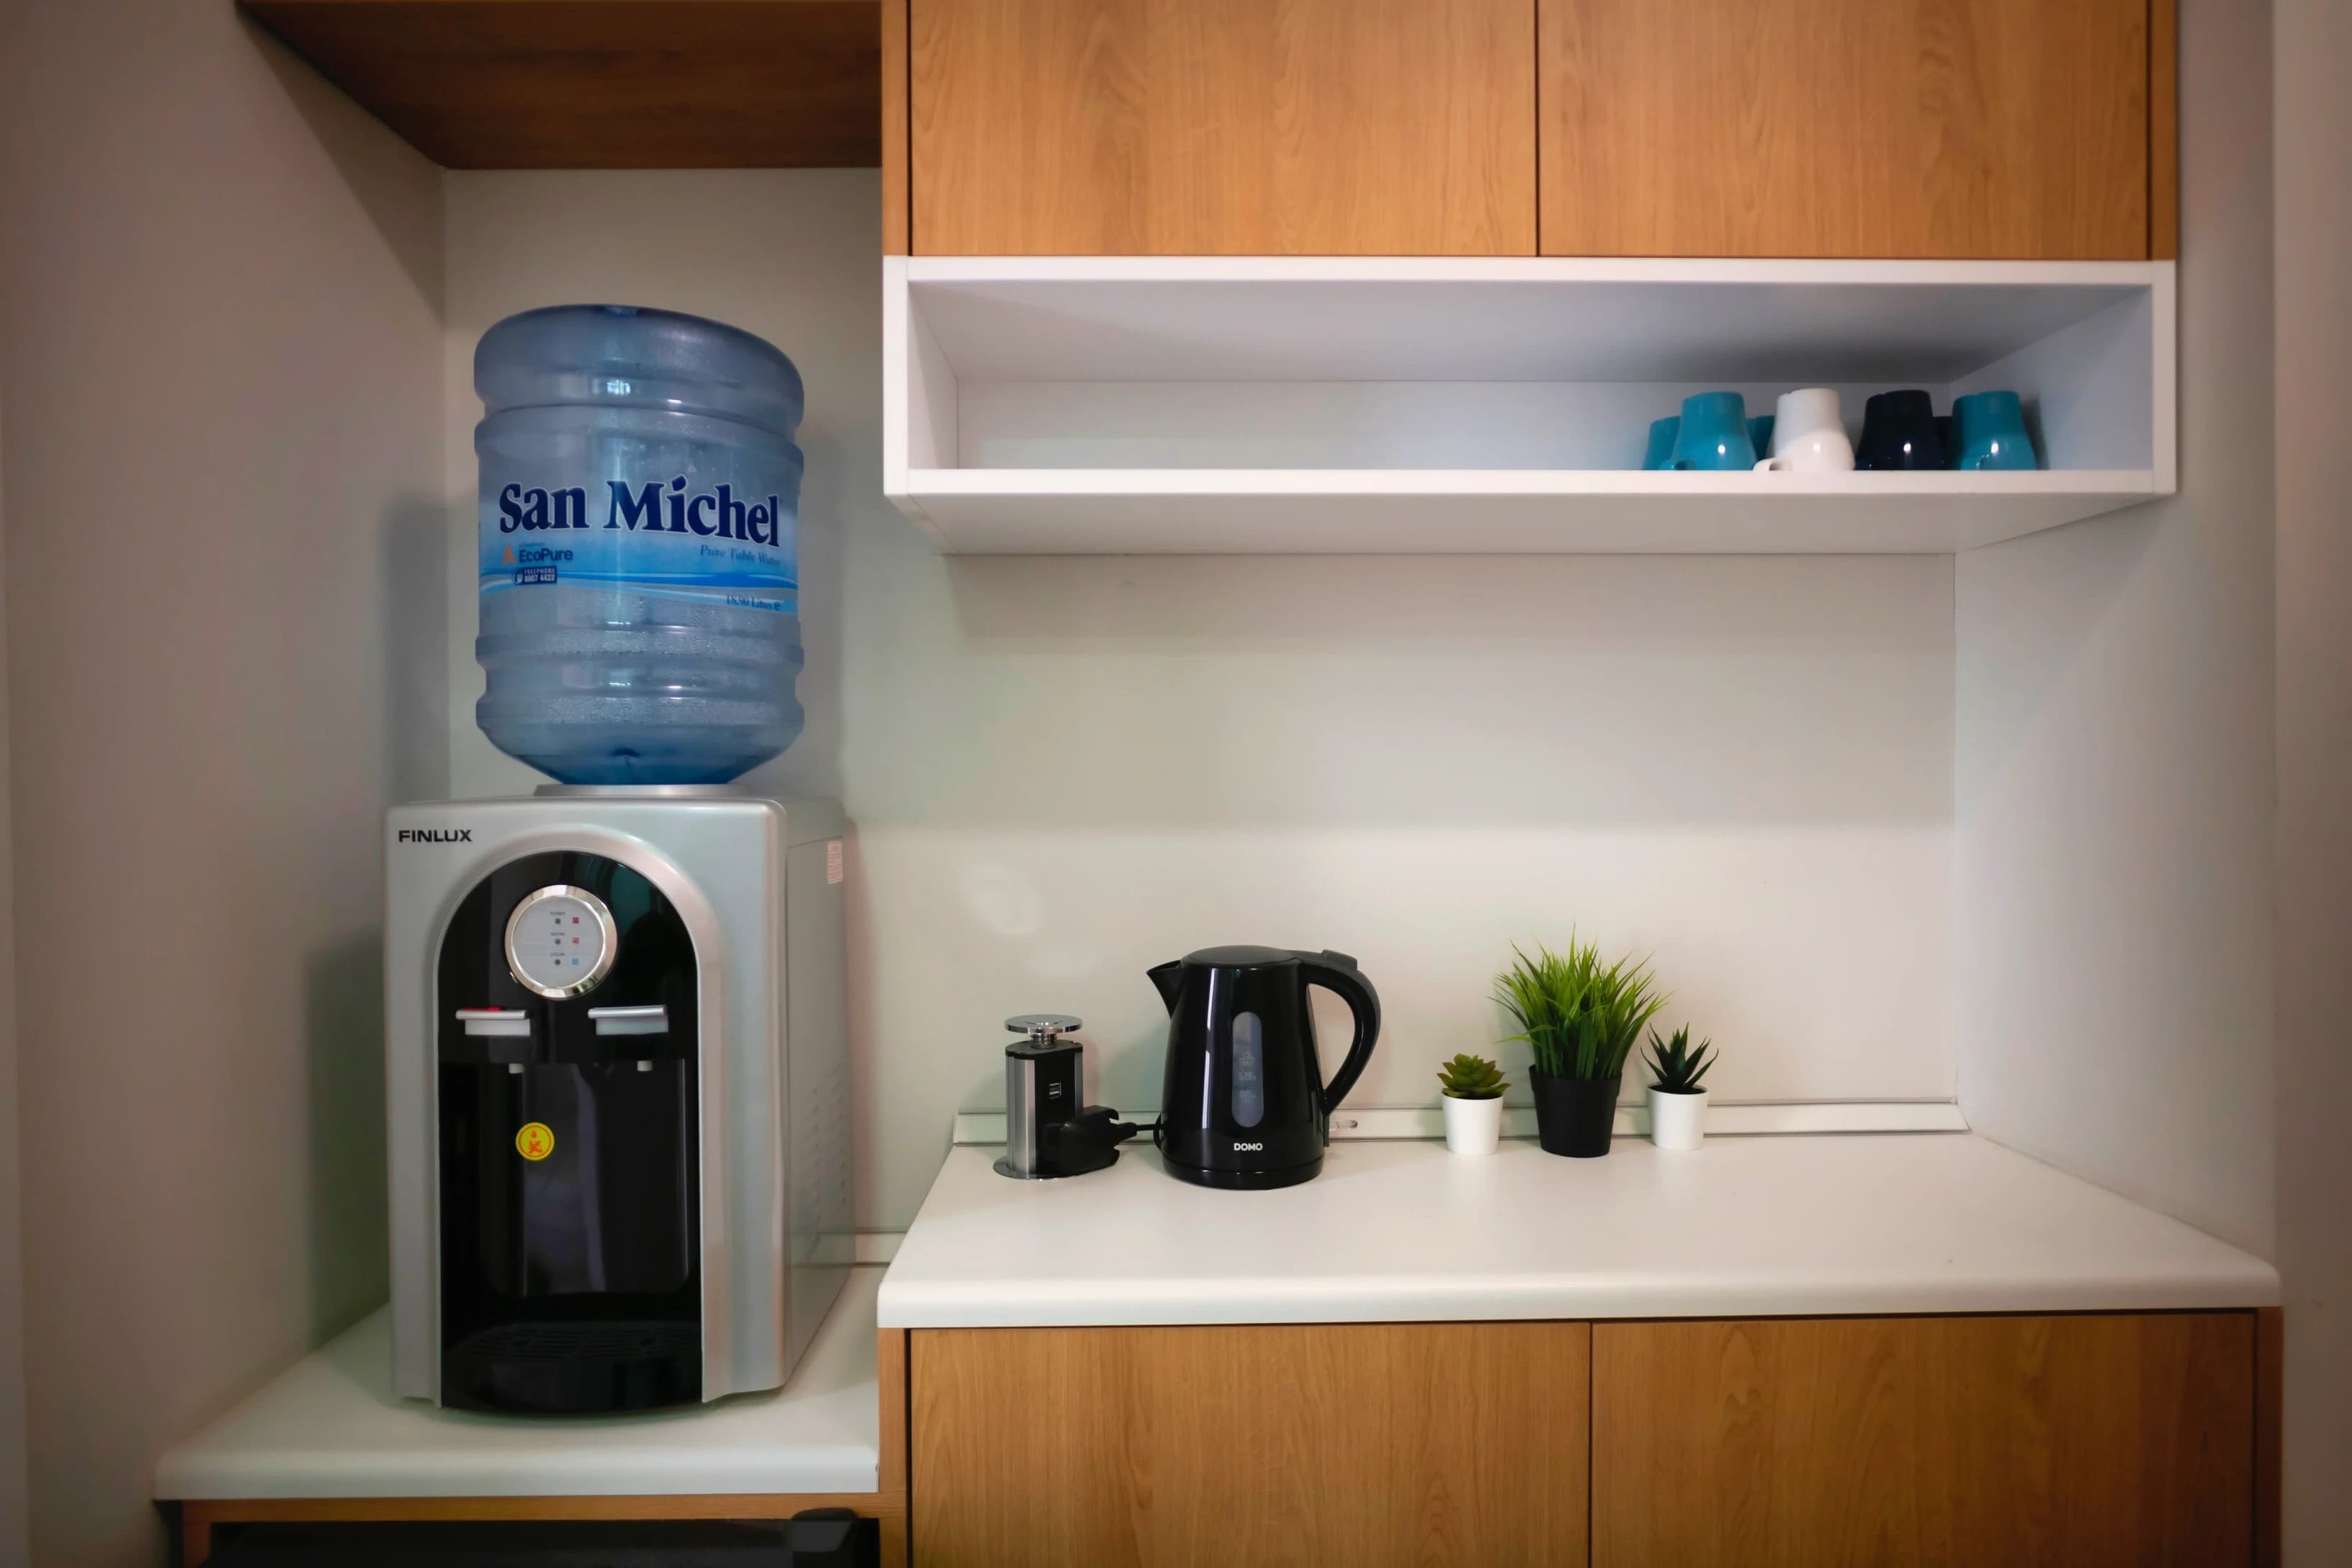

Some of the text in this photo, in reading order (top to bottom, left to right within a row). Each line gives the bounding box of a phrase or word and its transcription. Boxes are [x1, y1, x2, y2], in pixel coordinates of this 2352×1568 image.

[500, 474, 780, 548] San Michel
[519, 548, 573, 563] EcoPure
[700, 545, 725, 558] Pure
[398, 829, 472, 842] FINLUX
[1234, 1143, 1263, 1151] DOMO
